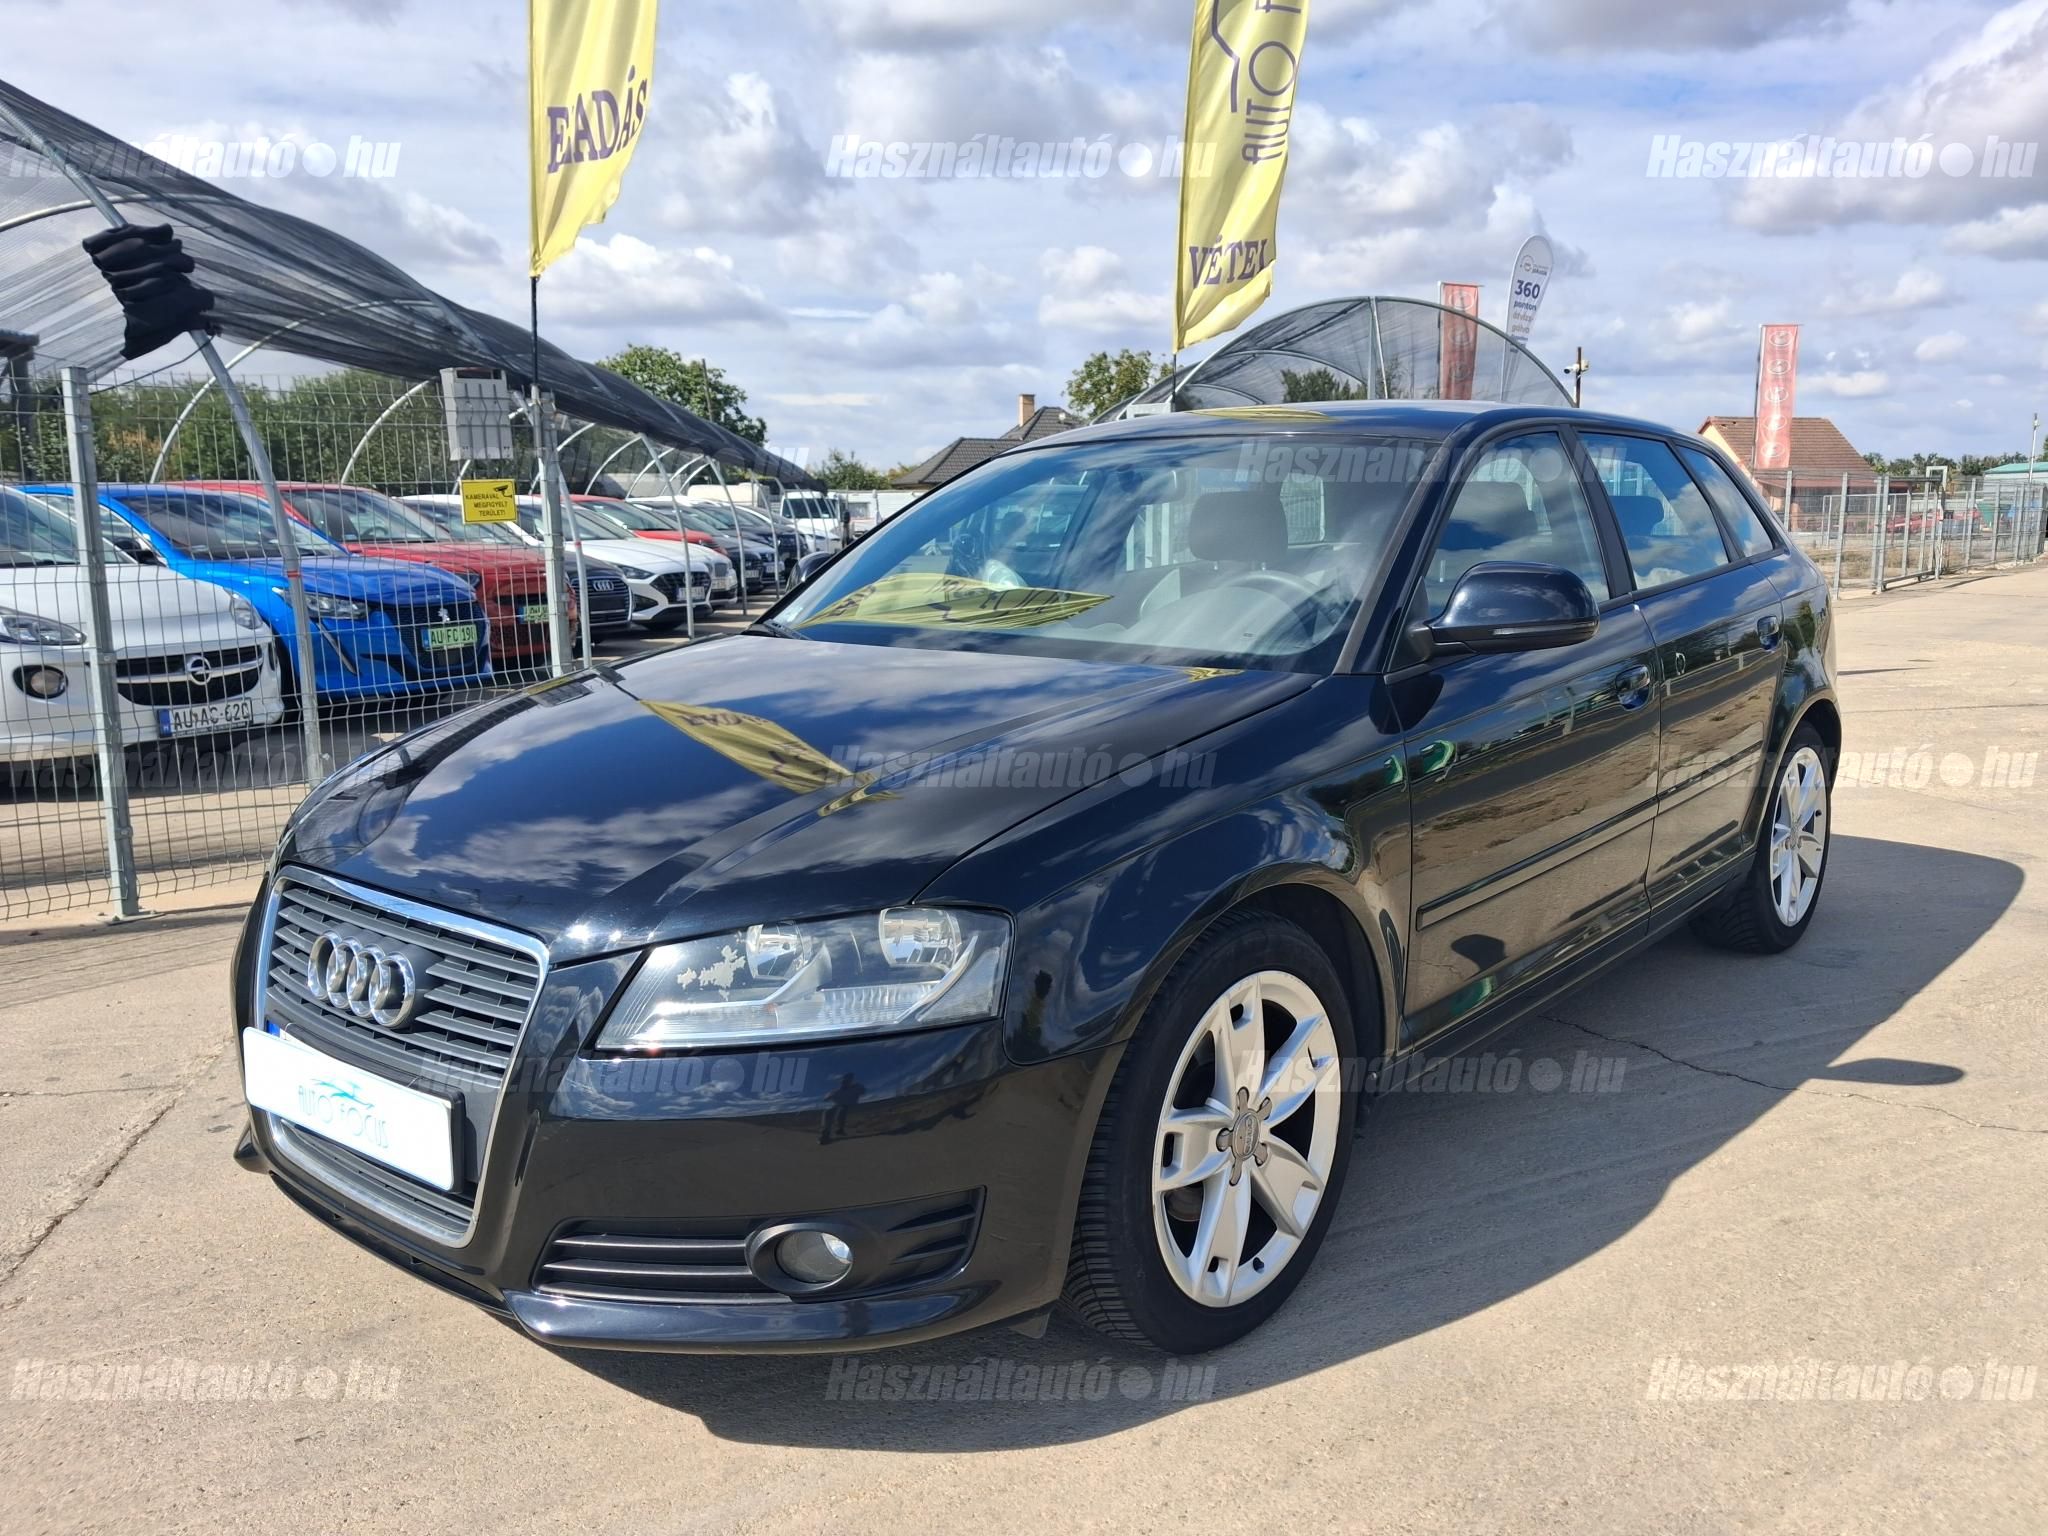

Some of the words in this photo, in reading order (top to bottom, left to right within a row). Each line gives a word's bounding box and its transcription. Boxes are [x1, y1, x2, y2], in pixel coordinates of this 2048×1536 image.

[546, 65, 648, 174] EADÁS
[1241, 41, 1297, 164] AUTO
[1514, 279, 1541, 300] 360
